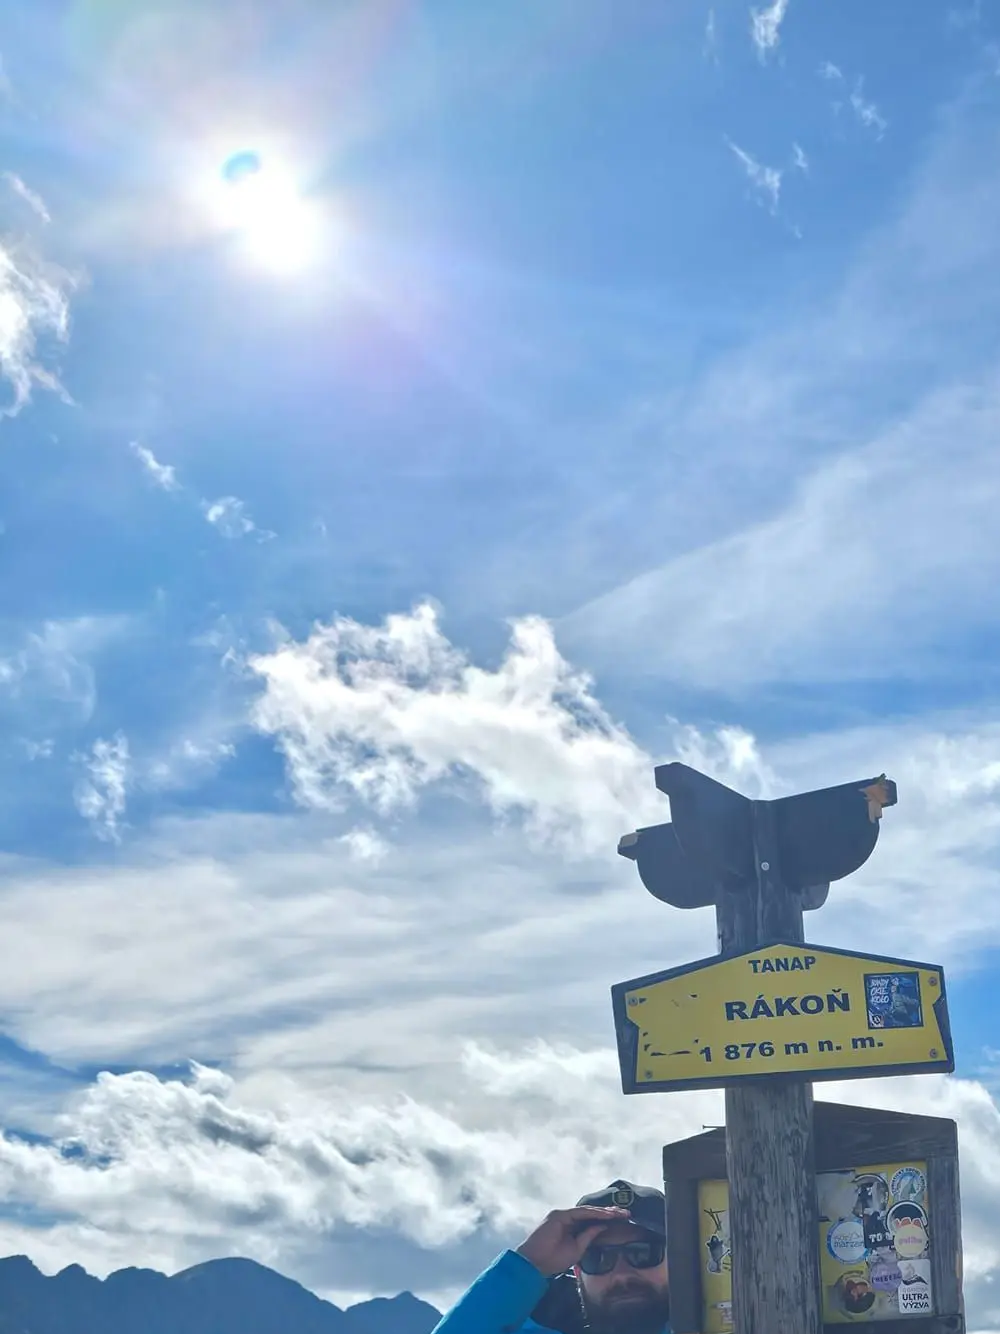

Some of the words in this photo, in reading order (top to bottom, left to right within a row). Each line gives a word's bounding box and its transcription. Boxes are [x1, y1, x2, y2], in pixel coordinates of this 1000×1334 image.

[748, 956, 816, 974] TANAP
[724, 988, 851, 1021] RÁKOŇ
[699, 1046, 712, 1062] 1
[724, 1041, 775, 1060] 876
[784, 1041, 808, 1055] m
[818, 1039, 842, 1052] n.
[851, 1036, 884, 1049] m.
[902, 1292, 929, 1301] ULTRA
[902, 1301, 930, 1309] VÝZVA
